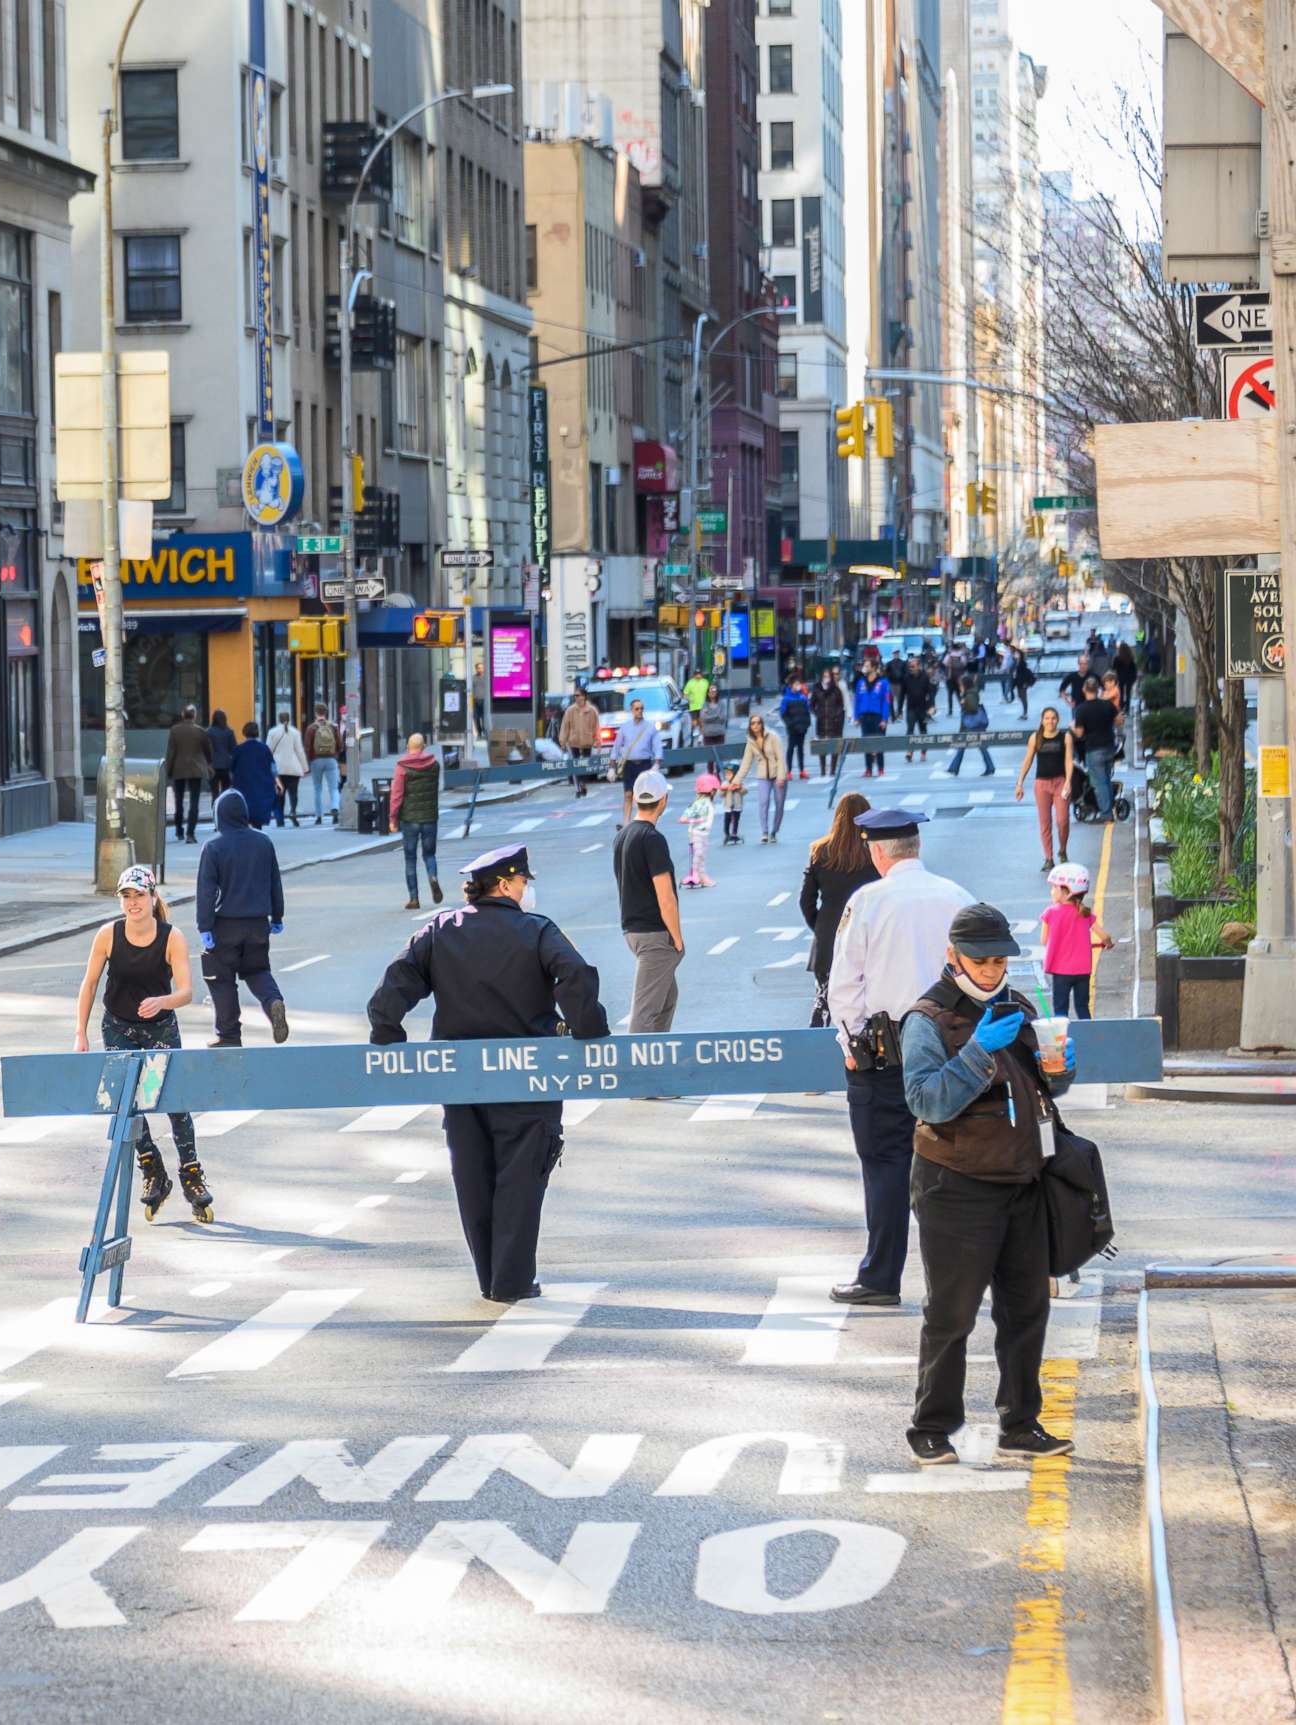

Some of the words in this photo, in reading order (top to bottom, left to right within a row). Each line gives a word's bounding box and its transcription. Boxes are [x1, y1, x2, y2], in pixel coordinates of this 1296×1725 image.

[1221, 309, 1266, 329] ONE
[533, 390, 546, 463] FIRST
[303, 539, 308, 551] E
[1260, 576, 1280, 588] PA
[326, 585, 344, 596] ONE
[355, 583, 376, 593] WAY
[1250, 590, 1281, 603] AVE
[1256, 621, 1284, 633] MA
[542, 760, 567, 770] POLICE
[365, 1049, 456, 1074] POLICE
[481, 1046, 538, 1071] LINE
[584, 1043, 618, 1068] DO
[631, 1040, 682, 1067] NOT
[695, 1037, 784, 1064] CROSS
[528, 1073, 619, 1092] NYPD
